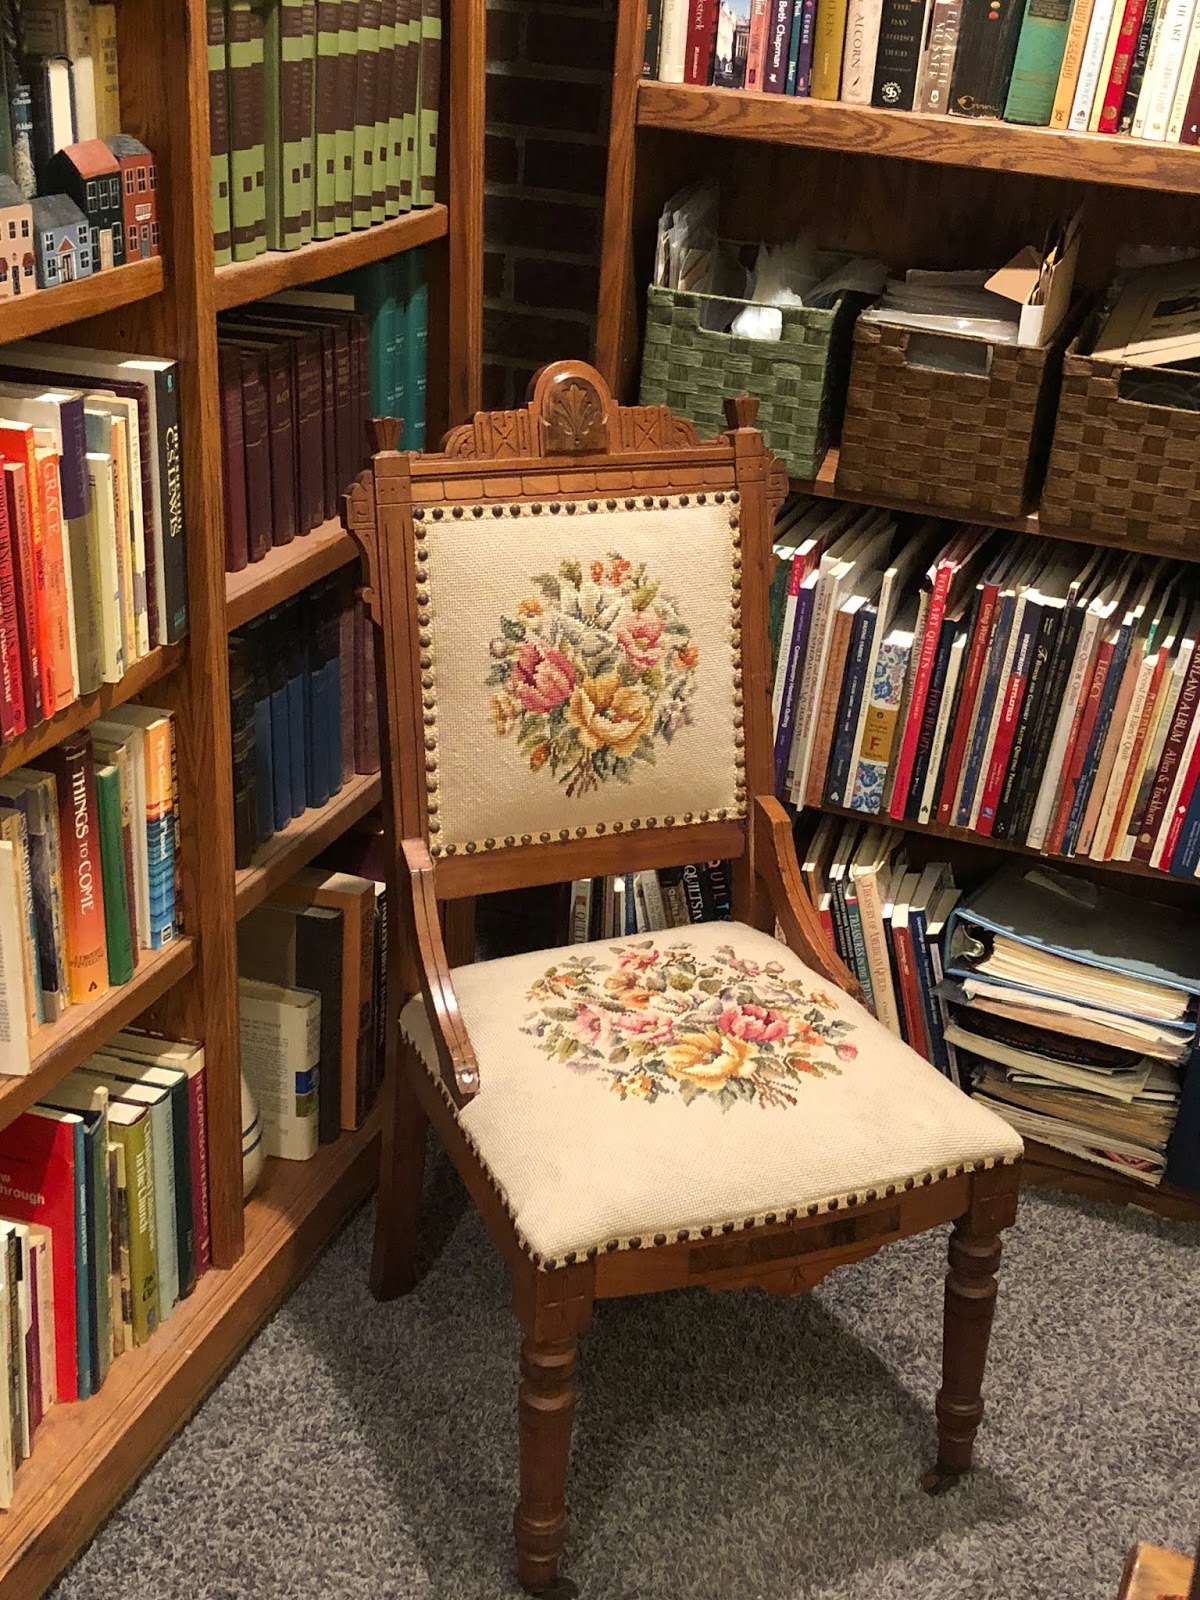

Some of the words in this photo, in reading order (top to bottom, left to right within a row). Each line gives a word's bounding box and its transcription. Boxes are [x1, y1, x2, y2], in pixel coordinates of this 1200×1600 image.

[777, 0, 788, 22] Beth
[893, 3, 912, 12] THE
[802, 13, 811, 44] GEORGE
[890, 18, 909, 26] DAY
[773, 24, 785, 68] Chapman
[851, 13, 864, 69] ALCORN
[882, 33, 916, 43] CHRIST
[929, 22, 945, 79] MUSSER
[938, 10, 958, 88] ELIZABETH
[884, 49, 908, 57] DIED
[44, 461, 59, 537] GRACE
[168, 467, 178, 538] LEWIS
[933, 573, 947, 602] FOLK
[818, 618, 826, 635] CRIB
[928, 605, 940, 627] ART
[979, 602, 992, 625] Going
[779, 632, 791, 662] CLASSIC
[814, 636, 823, 662] QUILTS
[911, 612, 928, 665] FLOWERING
[919, 628, 935, 669] QUILTS
[1082, 629, 1093, 651] Kansas
[788, 645, 800, 681] Contemporary
[1014, 631, 1030, 674] HOMEFRONT
[1074, 651, 1088, 672] Quilts
[774, 664, 786, 691] QUILTS
[809, 676, 817, 693] Other
[909, 666, 917, 677] OF
[1088, 658, 1108, 701] LEGACY
[1137, 666, 1152, 693] Pieced
[1183, 645, 1200, 702] RYLAND
[903, 678, 914, 708] QUILTS
[1004, 678, 1020, 722] BATTLEFIELD
[1028, 681, 1036, 694] AND
[1066, 680, 1080, 706] Quilters
[806, 694, 814, 713] Small
[925, 688, 941, 715] FOLK
[1022, 693, 1034, 721] COMFORT
[1132, 693, 1144, 713] from
[780, 707, 790, 727] Quilting
[1124, 714, 1139, 741] Ellen's
[1170, 701, 1194, 743] ALBUM
[870, 736, 881, 750] F
[917, 715, 936, 756] HEARTS
[1016, 724, 1026, 745] NATIVE
[157, 736, 166, 762] The
[1009, 745, 1022, 772] QUILTING
[1118, 740, 1131, 762] Quilt
[1160, 747, 1177, 774] Allen
[1002, 772, 1015, 804] TRADITIONS
[1157, 773, 1169, 785] &
[72, 767, 89, 838] THINGS
[79, 842, 89, 858] TO
[159, 819, 169, 862] Flood
[20, 812, 35, 915] PSYCHOHERESY
[78, 860, 95, 916] COME
[682, 864, 703, 911] QUILTS
[861, 883, 876, 919] TREASURY
[667, 888, 679, 917] Quilts
[835, 911, 843, 925] FROM
[841, 913, 849, 926] FROM
[868, 921, 877, 930] OF
[916, 917, 925, 943] Uncoverings
[837, 926, 847, 957] YESTERYEAR
[844, 928, 854, 958] YESTERYEAR
[848, 914, 865, 957] TREASURES
[858, 966, 868, 978] THE
[870, 931, 883, 968] AMERICAN
[874, 967, 887, 993] QUILTS
[137, 1168, 147, 1188] the
[138, 1189, 148, 1234] Church
